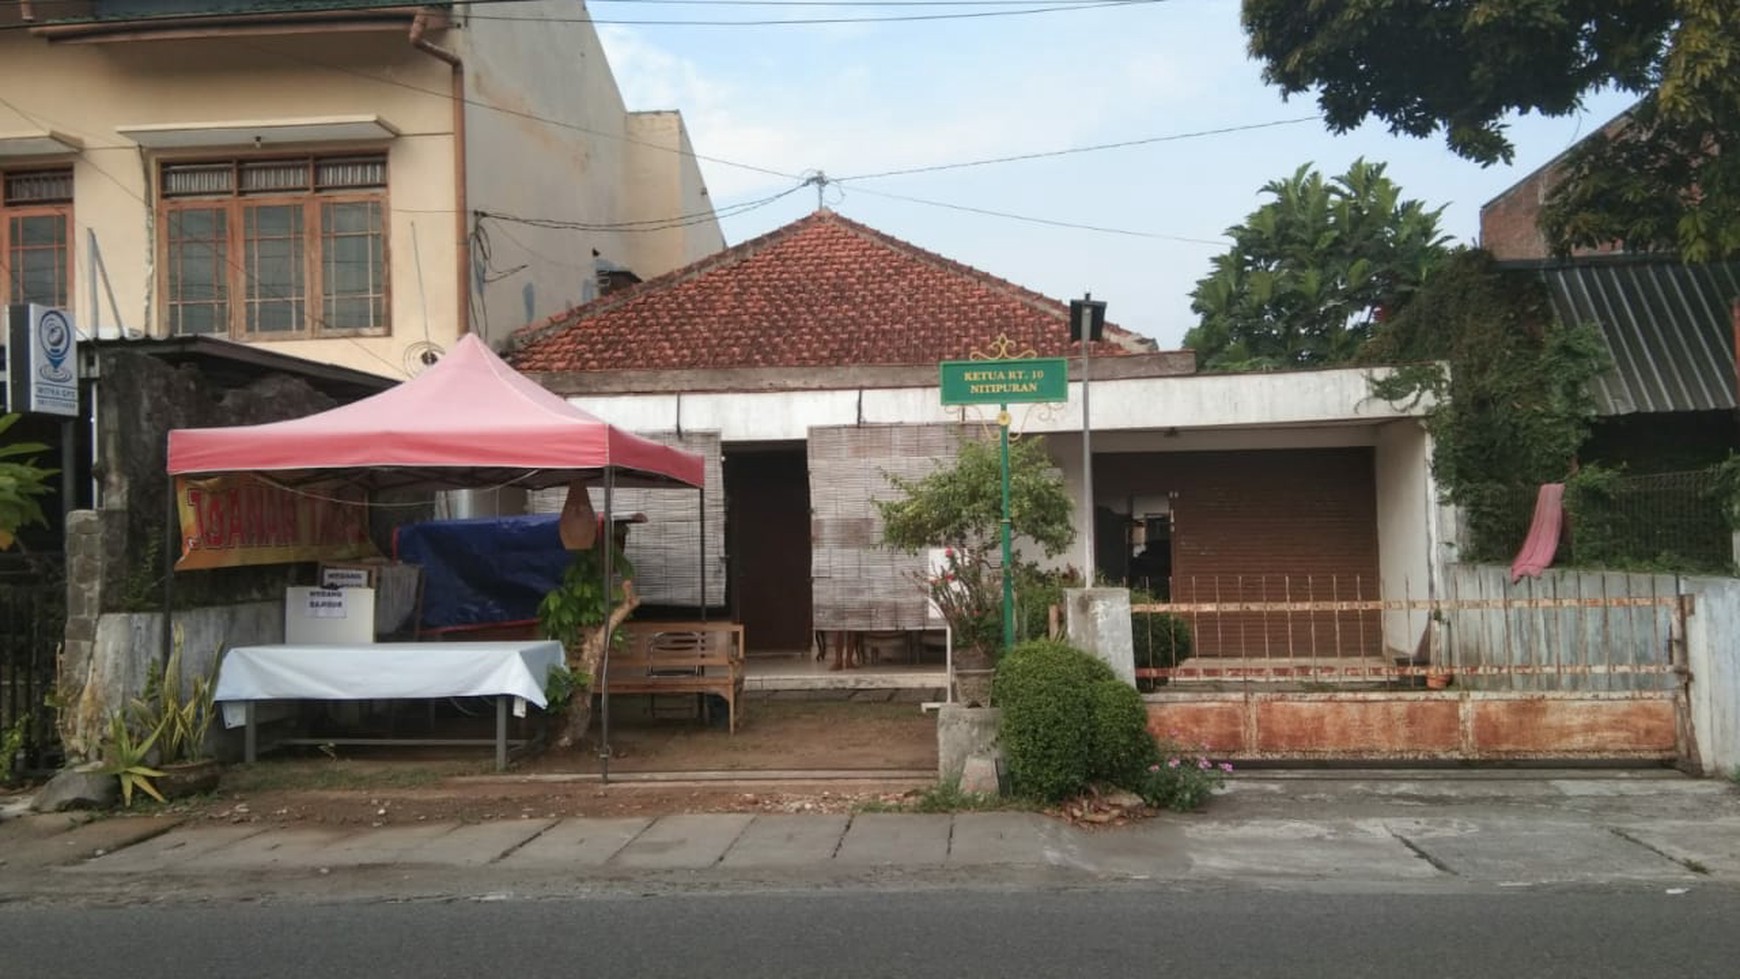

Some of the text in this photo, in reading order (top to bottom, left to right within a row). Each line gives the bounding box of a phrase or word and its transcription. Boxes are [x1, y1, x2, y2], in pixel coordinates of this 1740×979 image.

[964, 369, 1044, 381] KETUA RT. 10
[970, 382, 1038, 393] NITIPURAN
